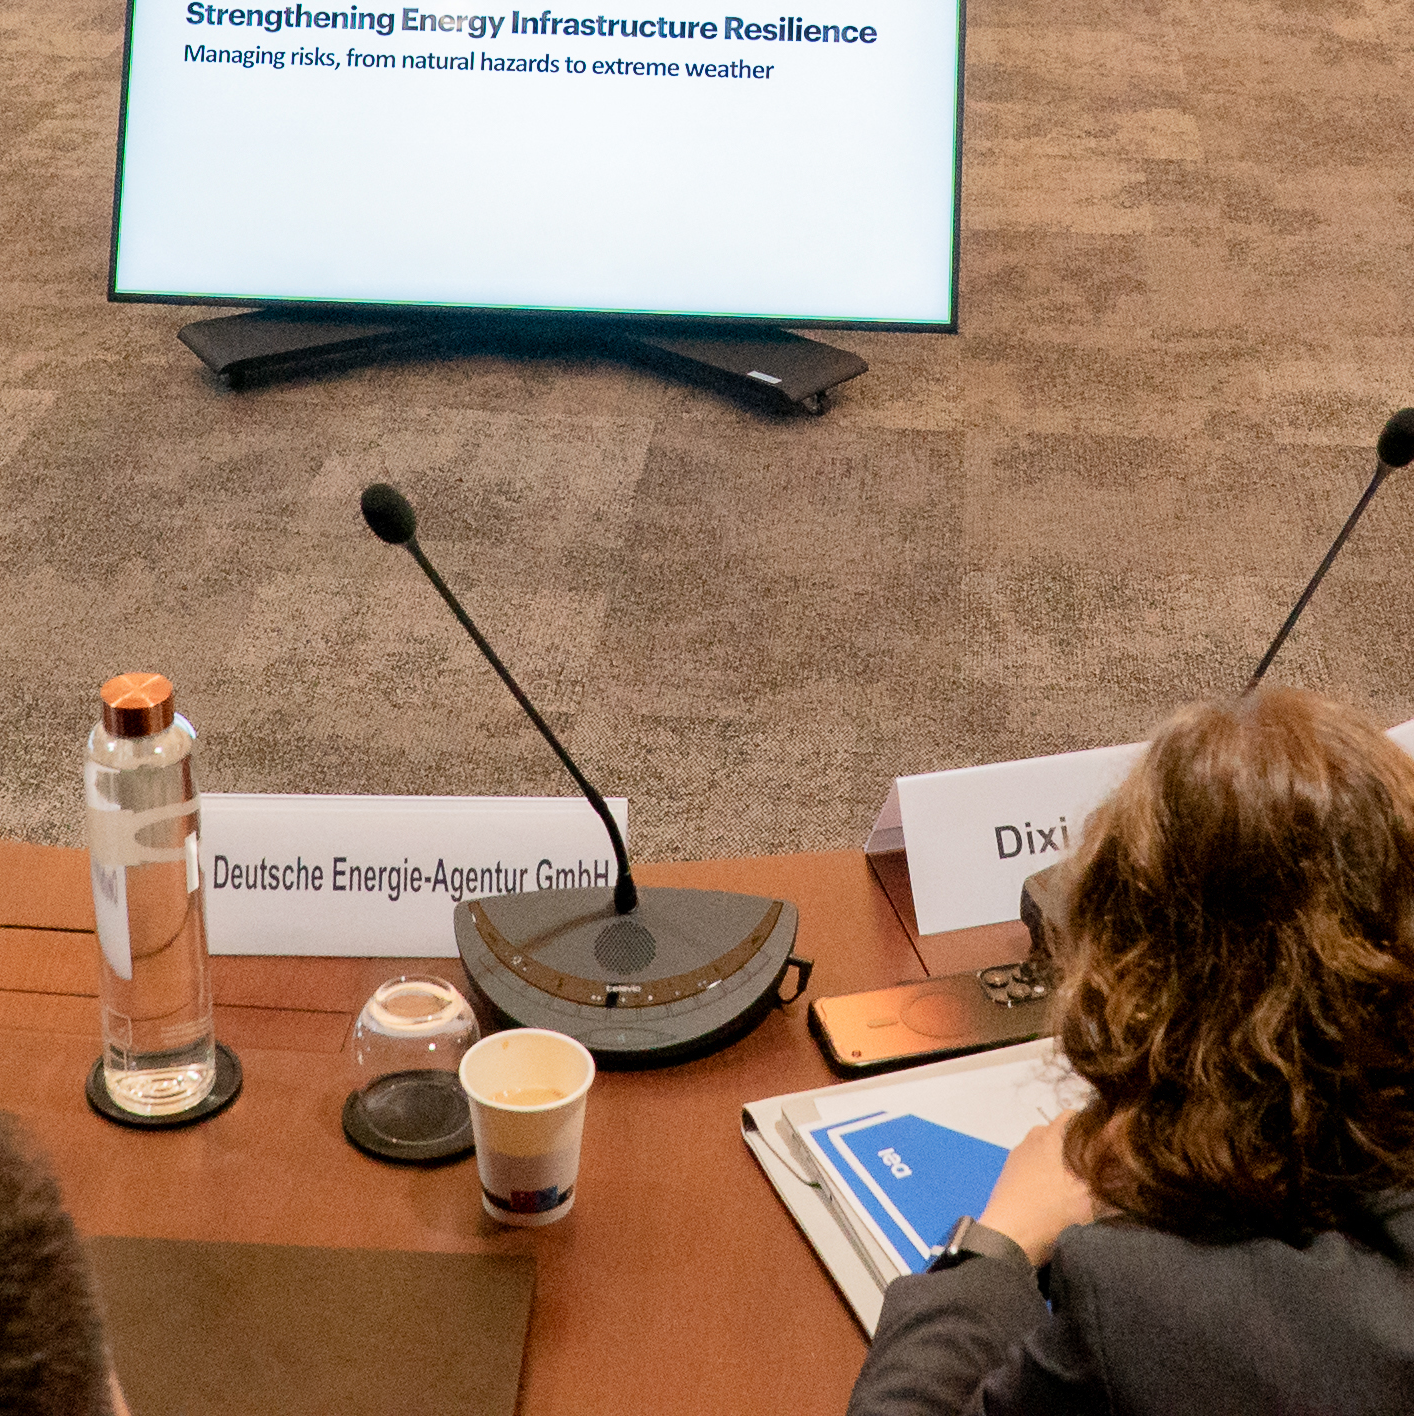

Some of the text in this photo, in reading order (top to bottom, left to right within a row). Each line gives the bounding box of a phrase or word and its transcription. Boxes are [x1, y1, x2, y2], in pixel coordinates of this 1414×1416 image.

[185, 1, 878, 44] Strengthening Energy Infrastructure Resilience
[183, 44, 775, 81] Managing risks, from natural hazards to extreme weather
[994, 816, 1070, 860] Dixi
[213, 854, 610, 902] Deutsche Energie-Agentur GmbH
